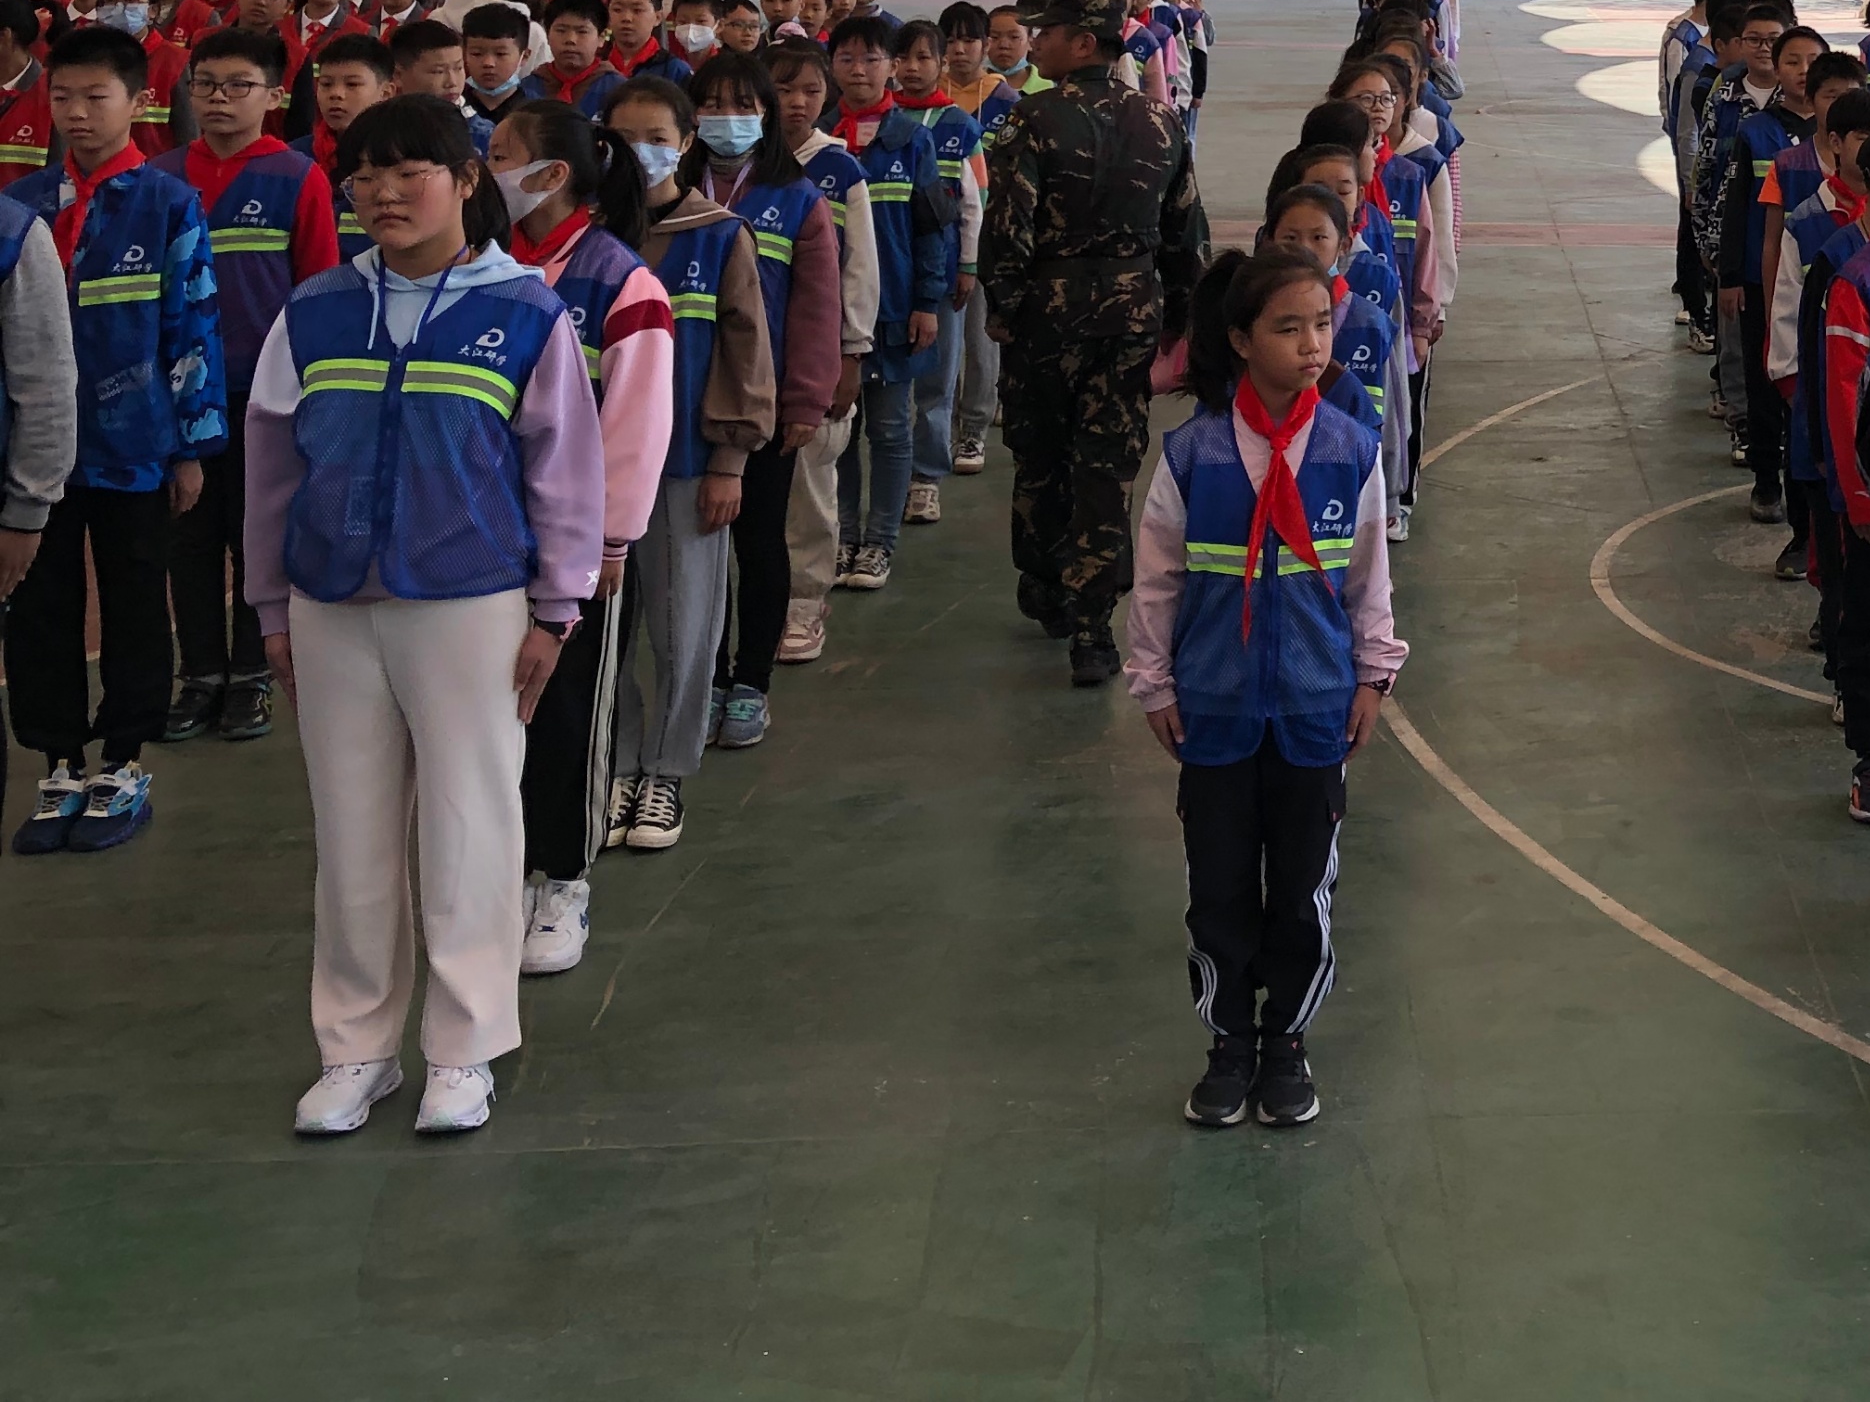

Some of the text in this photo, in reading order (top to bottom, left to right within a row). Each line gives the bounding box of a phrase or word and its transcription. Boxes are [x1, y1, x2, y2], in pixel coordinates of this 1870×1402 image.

[458, 345, 507, 366] 大江研学
[1312, 522, 1353, 536] 大江研学
